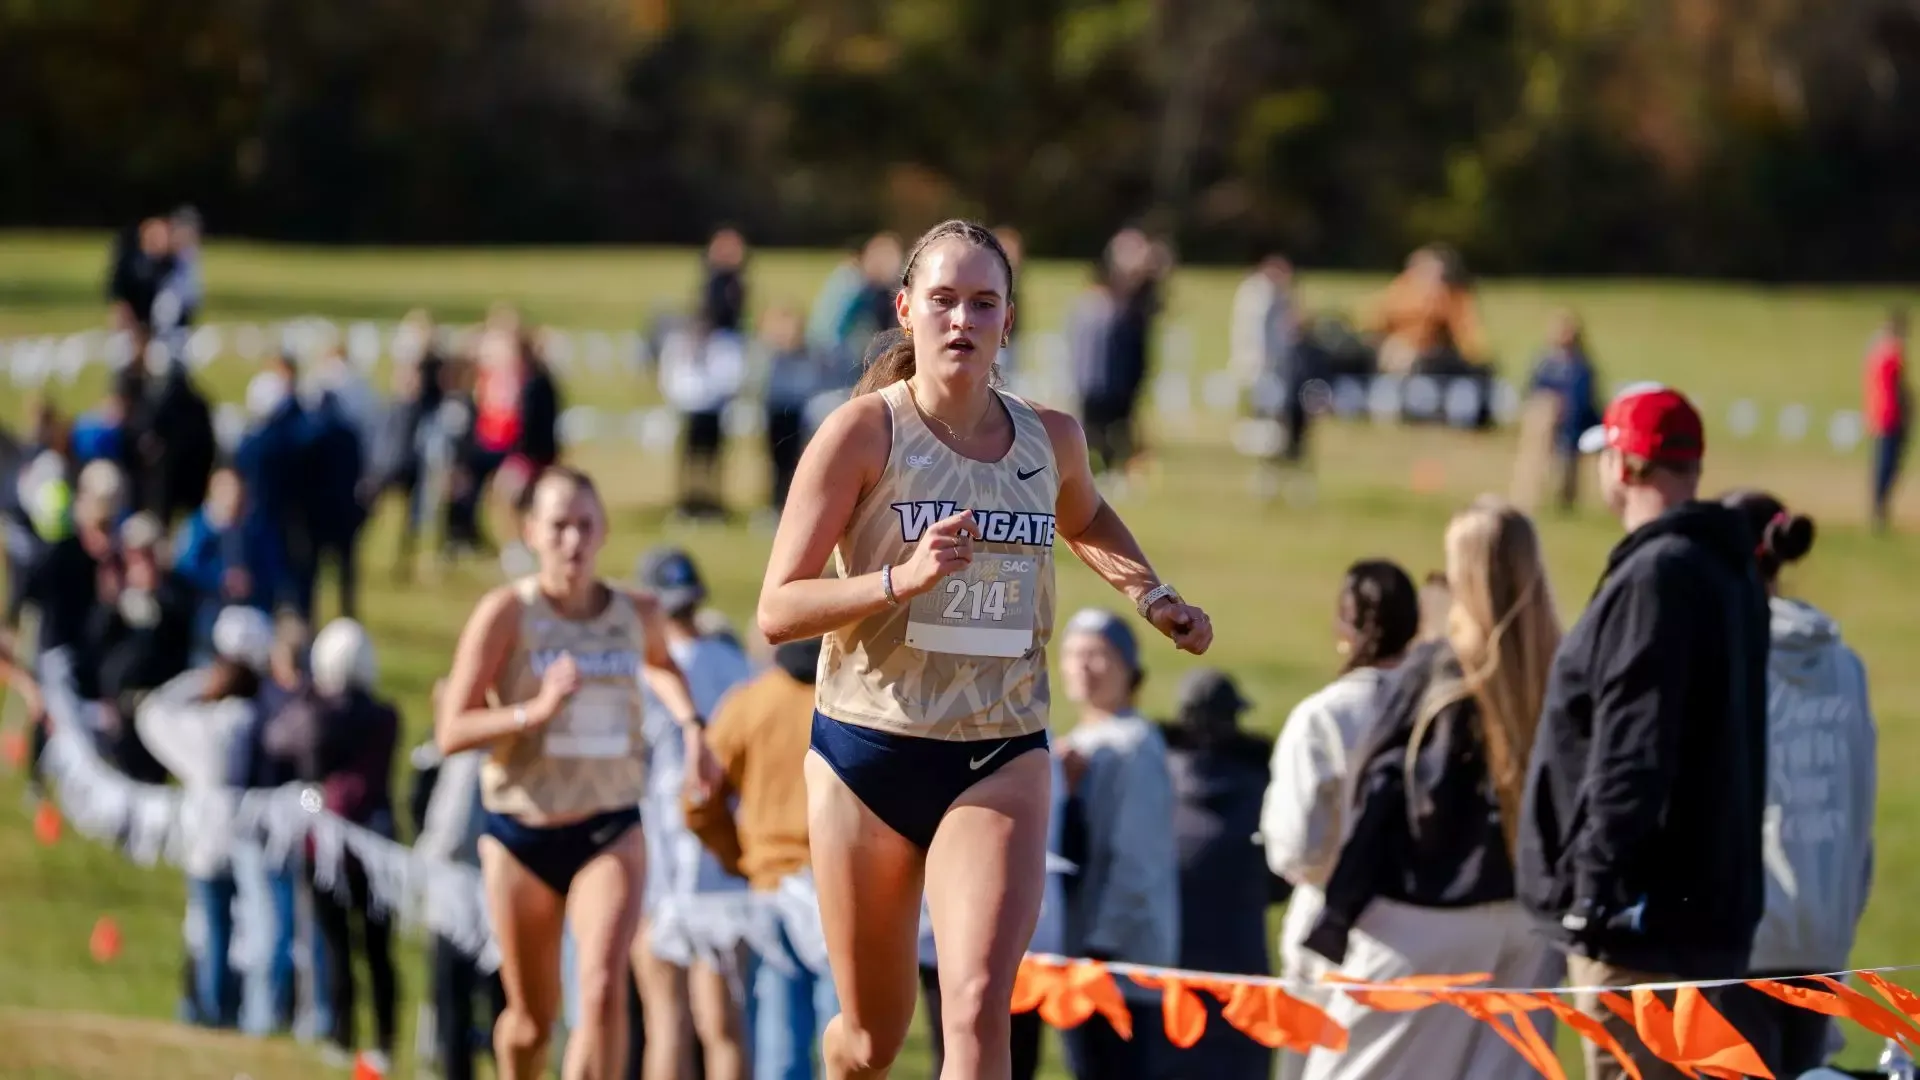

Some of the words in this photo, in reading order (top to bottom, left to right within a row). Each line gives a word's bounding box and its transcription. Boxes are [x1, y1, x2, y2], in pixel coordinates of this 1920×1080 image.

[909, 455, 933, 465] SAC
[1001, 560, 1029, 573] SAC
[942, 579, 1006, 621] 214
